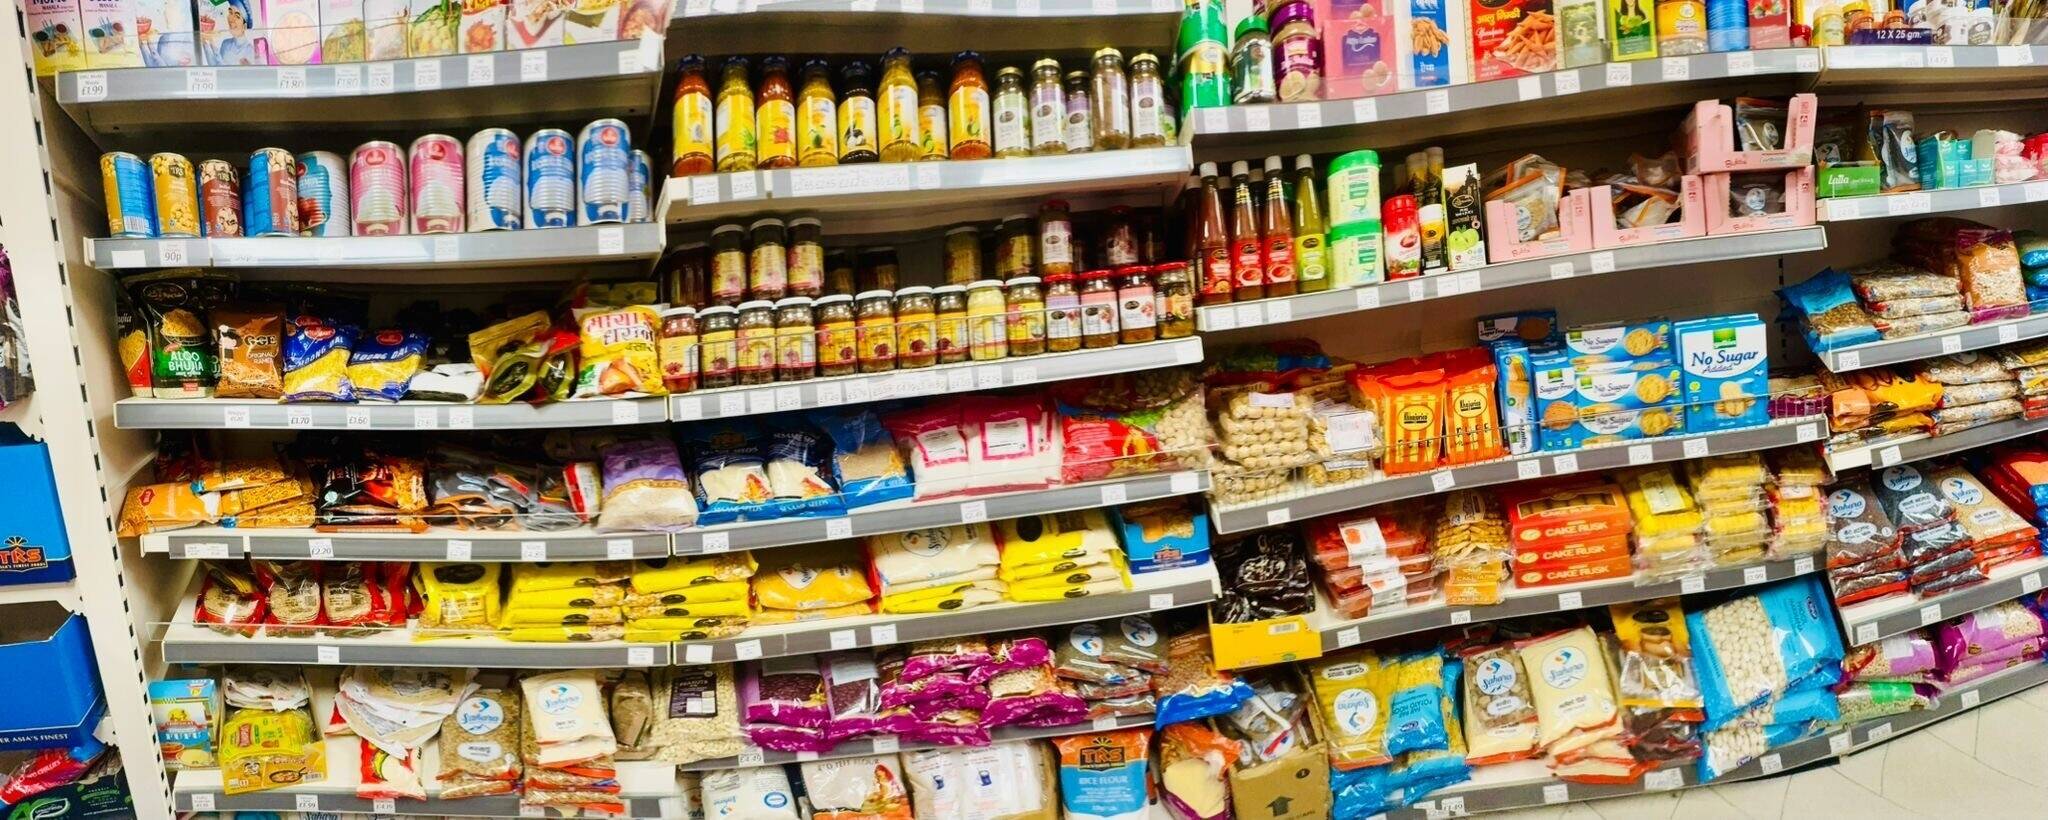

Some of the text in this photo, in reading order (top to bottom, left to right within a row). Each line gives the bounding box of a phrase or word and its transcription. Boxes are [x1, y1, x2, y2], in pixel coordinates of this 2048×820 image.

[1876, 30, 1922, 41] 12 X 25 gm.
[81, 85, 104, 96] £1.99
[164, 251, 182, 263] 90p
[170, 350, 200, 361] ALOO
[352, 346, 409, 361] MOONG DAL
[1691, 350, 1758, 367] No Sugar
[168, 361, 204, 372] BHUJIA
[291, 417, 309, 425] £1.70
[1889, 473, 1919, 487] Sahara
[1832, 500, 1863, 514] Sahara
[1544, 521, 1608, 537] CAKE RUSK
[0, 546, 42, 564] TRS
[1543, 545, 1606, 560] CAKE RUSK
[1546, 565, 1609, 579] CAKE RUSK
[1549, 663, 1585, 682] Sahara
[1482, 674, 1513, 690] Sahara
[462, 712, 499, 725] Sahara
[40, 733, 69, 741] FINEST
[1082, 748, 1122, 763] TRS
[1099, 776, 1128, 785] FLOUR
